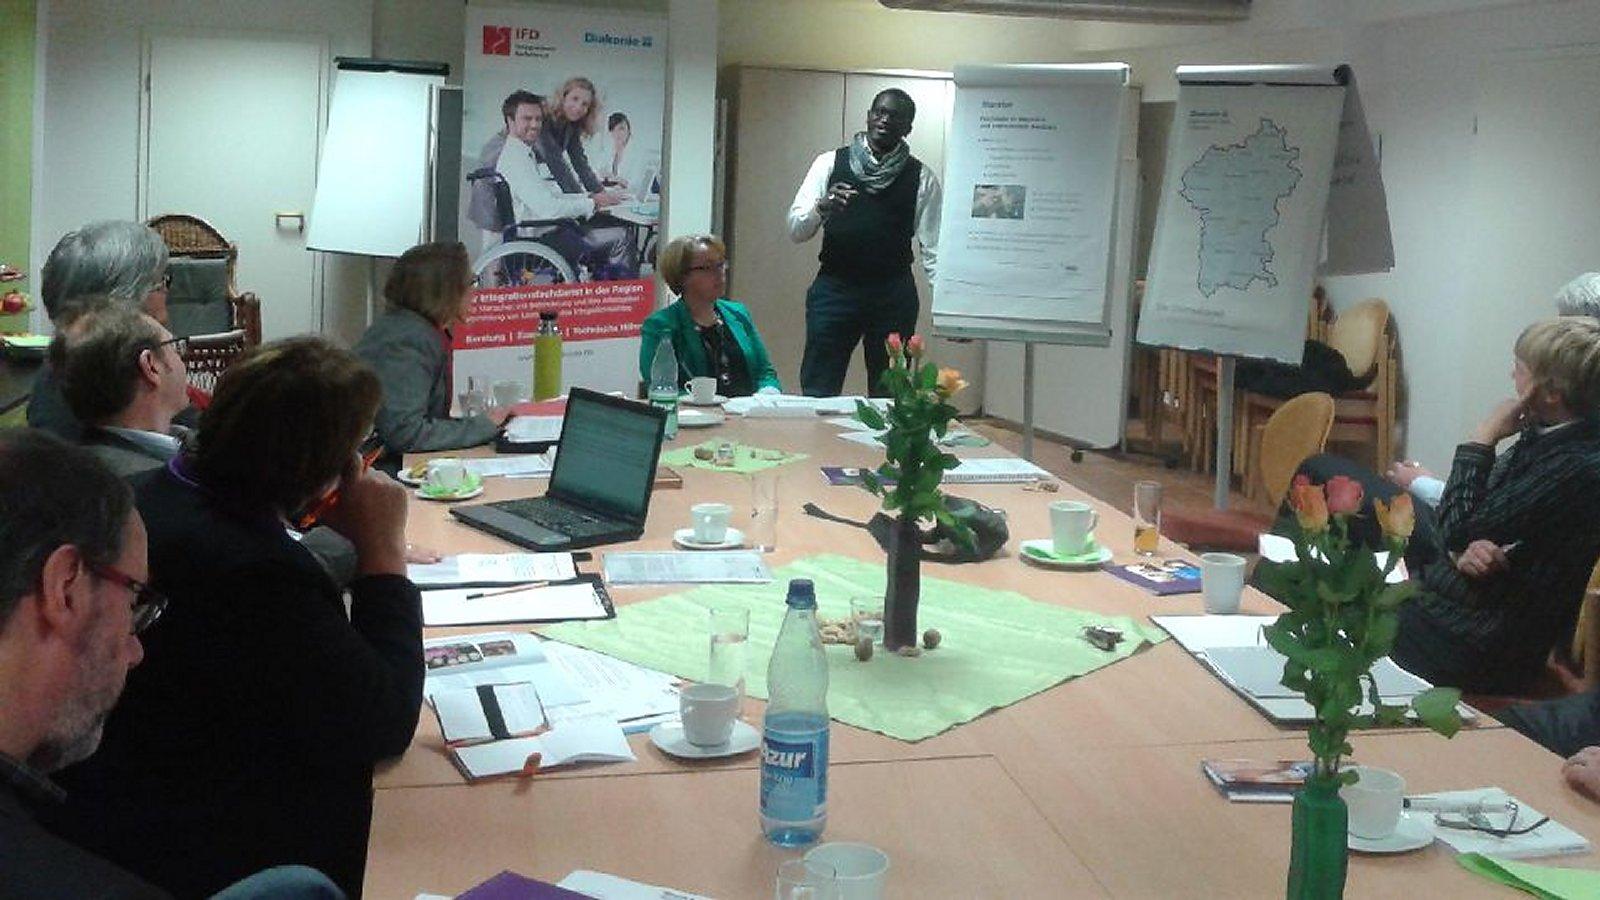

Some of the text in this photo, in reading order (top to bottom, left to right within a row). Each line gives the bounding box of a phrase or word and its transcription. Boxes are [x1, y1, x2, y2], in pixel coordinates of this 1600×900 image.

[515, 28, 540, 40] IFD
[480, 288, 584, 303] Integrationsfachdienst
[595, 285, 610, 295] der
[612, 284, 644, 294] Region
